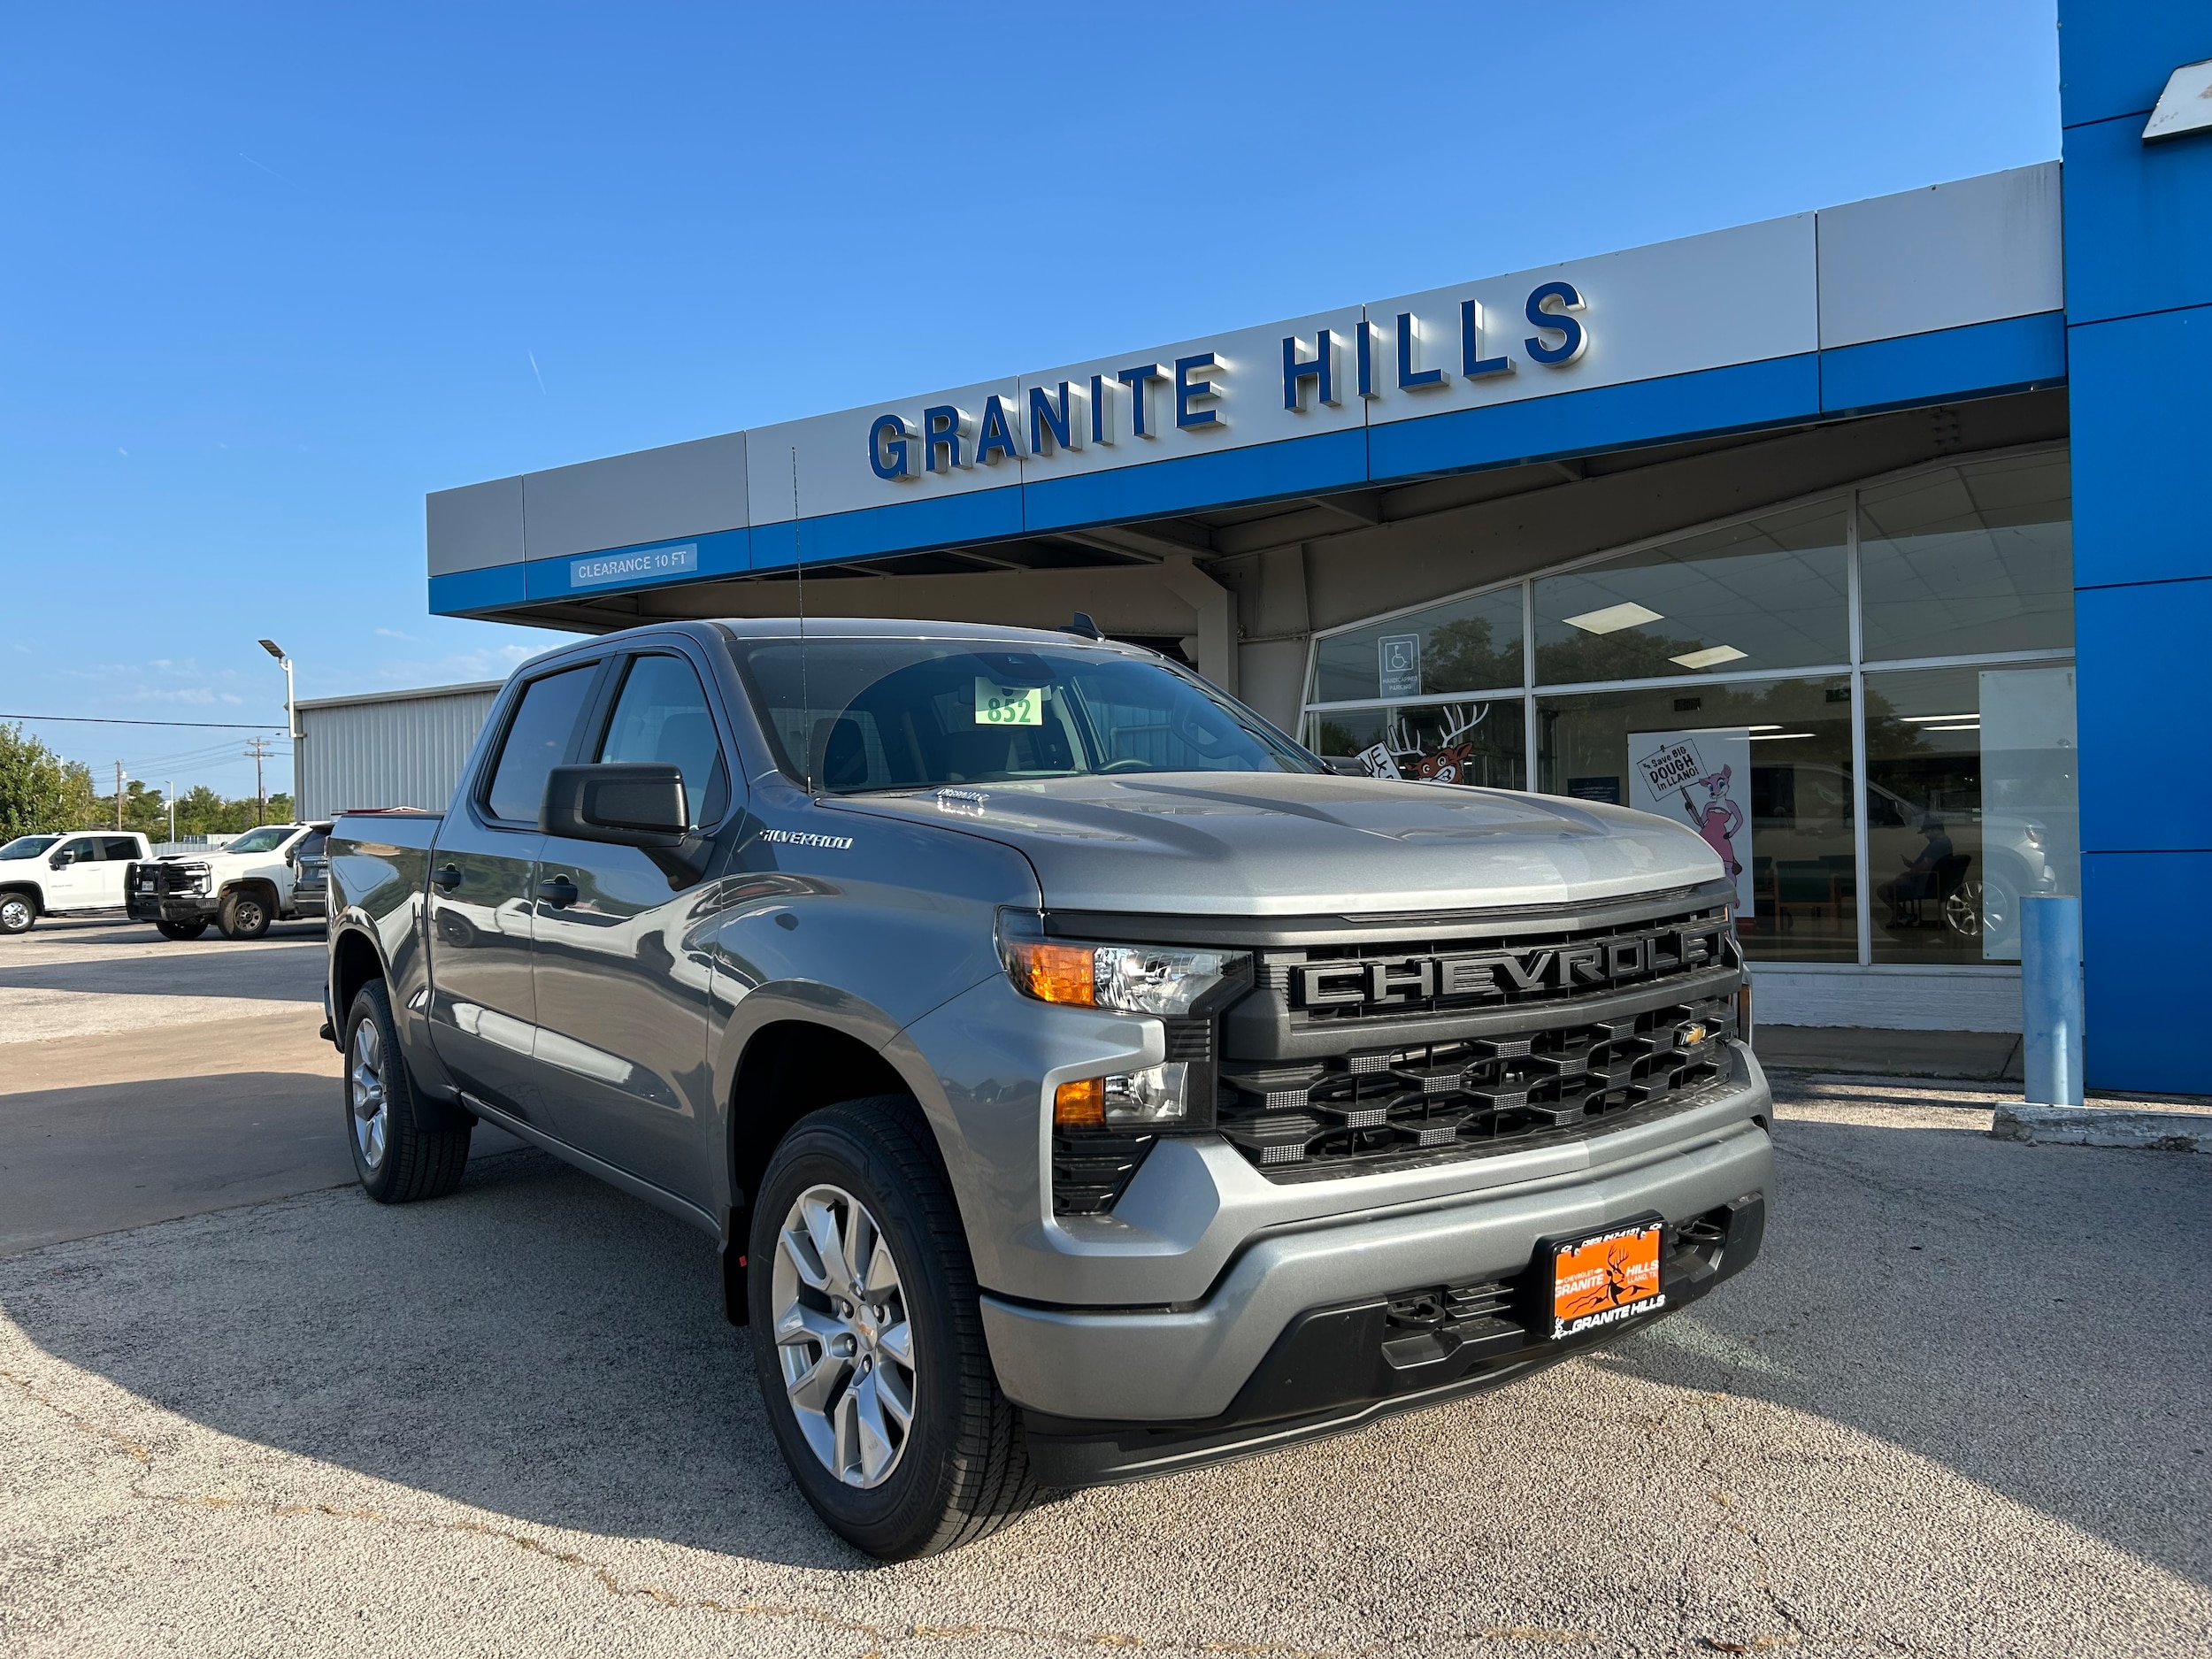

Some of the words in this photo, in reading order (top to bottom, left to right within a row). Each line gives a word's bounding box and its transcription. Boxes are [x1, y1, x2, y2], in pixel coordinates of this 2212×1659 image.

[868, 352, 1226, 482] GRANITE
[1282, 281, 1588, 413] HILLS
[579, 557, 651, 579] CLEARANCE
[655, 555, 668, 568] 10
[672, 551, 687, 565] FT
[1383, 675, 1417, 684] HANDICAPPED
[987, 698, 1031, 722] 852
[1651, 755, 1672, 767] Save
[1671, 746, 1686, 758] BIG
[1649, 753, 1694, 784] DOUGH
[1666, 766, 1700, 787] LLANO!
[1302, 922, 1732, 1007] CHEVROLET
[1563, 1270, 1594, 1283] CHEVROLET
[1626, 1259, 1659, 1277] HILLS
[1555, 1275, 1604, 1297] GRANITE
[1572, 1305, 1631, 1333] GRANITE
[1631, 1294, 1666, 1315] HILLS
